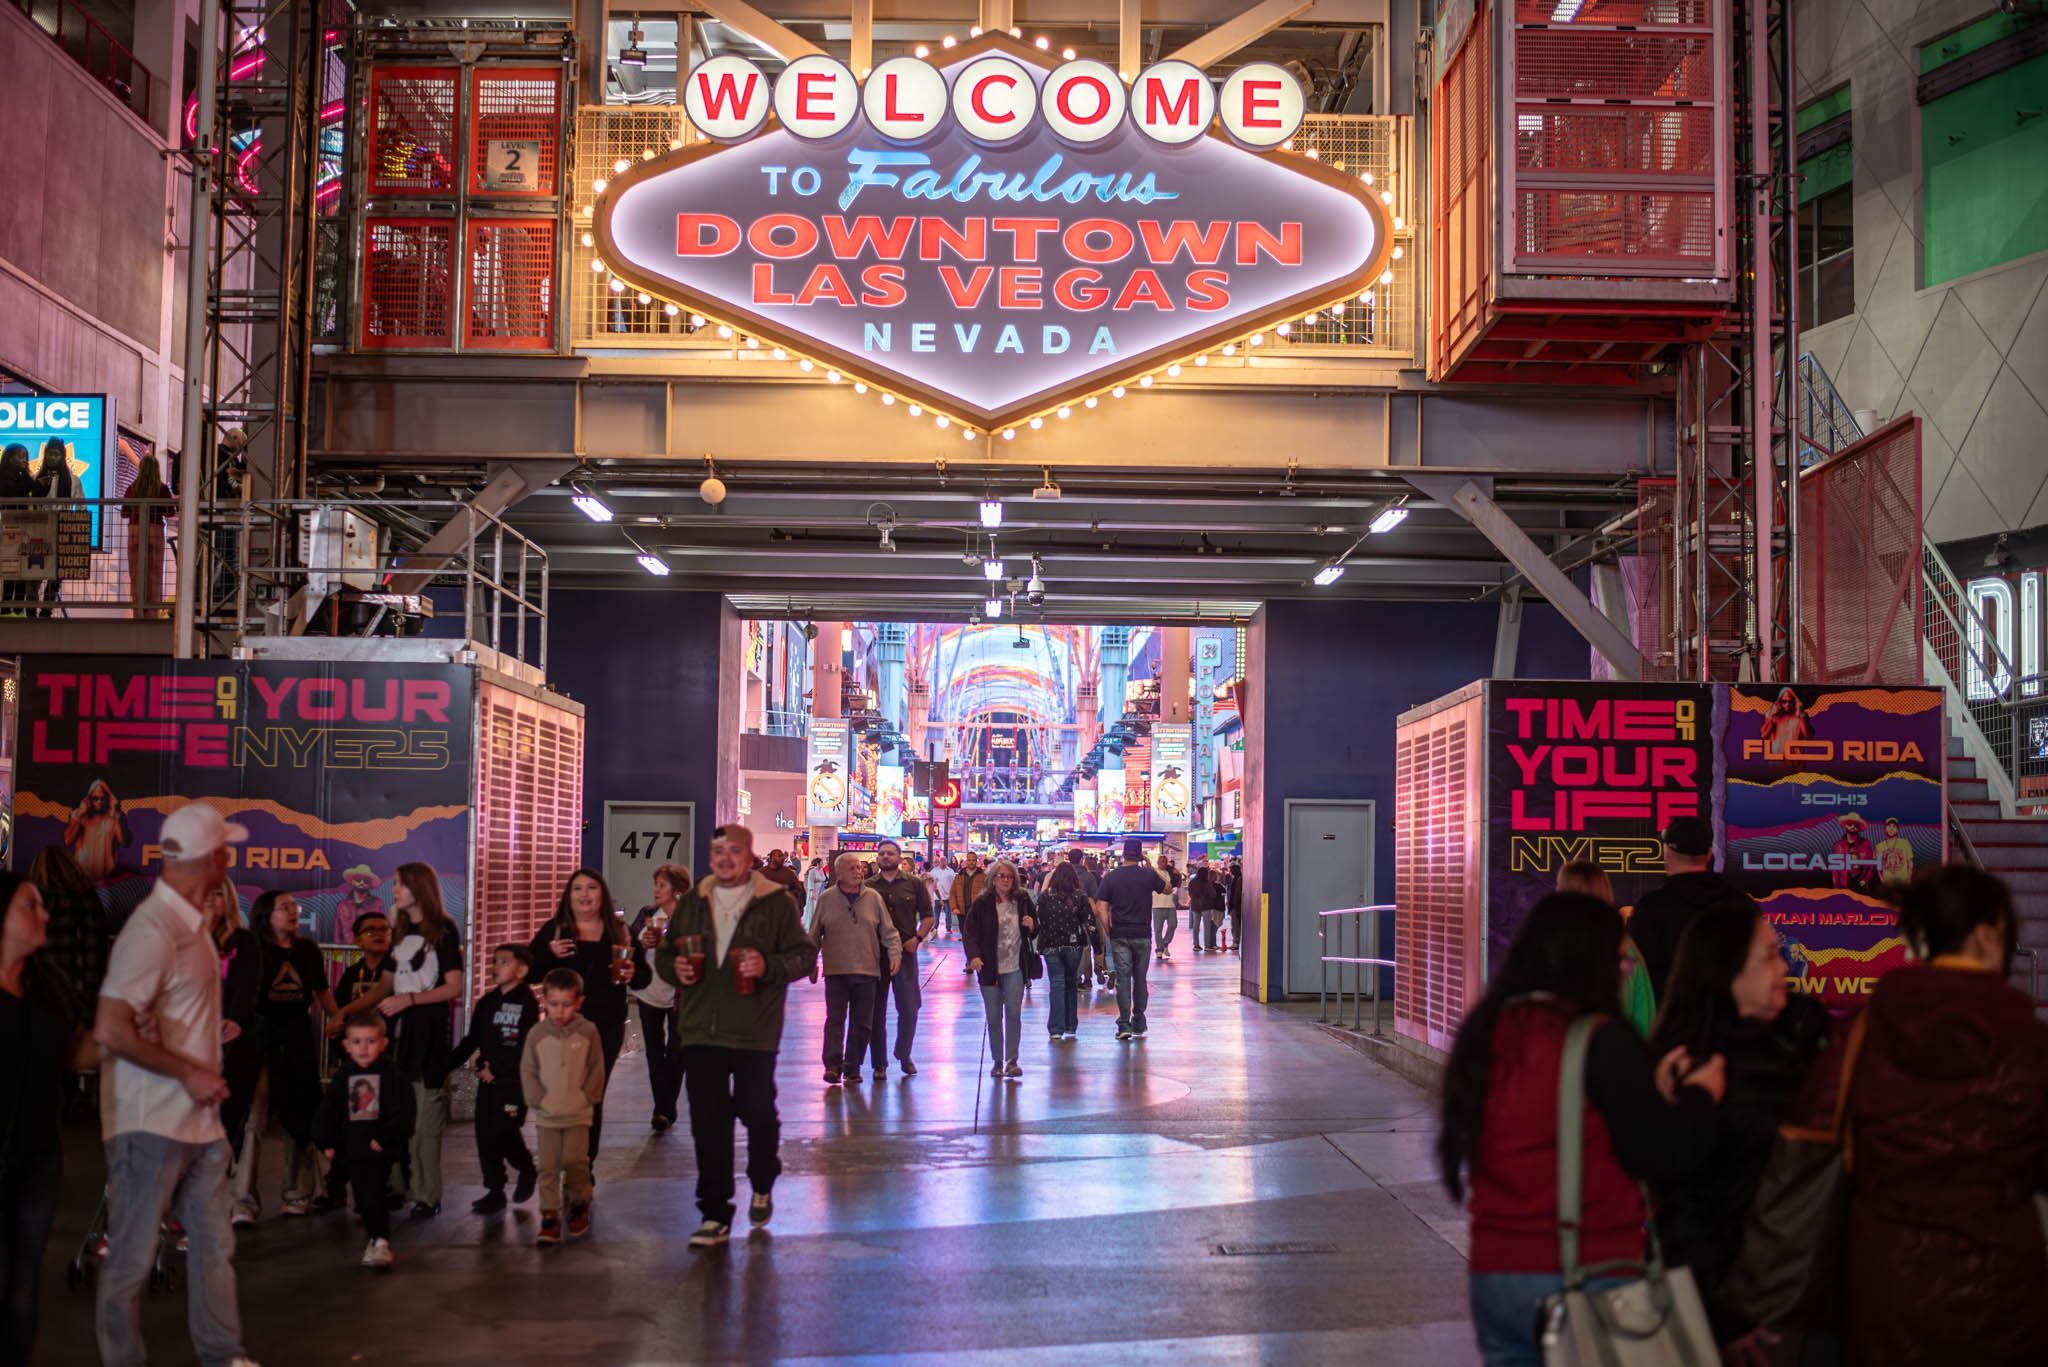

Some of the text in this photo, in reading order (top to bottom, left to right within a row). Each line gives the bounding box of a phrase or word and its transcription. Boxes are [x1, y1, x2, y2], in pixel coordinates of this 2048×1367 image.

[697, 73, 1284, 128] WELCOME
[501, 141, 527, 150] LEVEL
[505, 149, 521, 171] 2
[761, 147, 1180, 212] TO Fabulous
[675, 213, 1303, 266] DOWNTOWN
[752, 264, 1231, 312] LAS VEGAS
[864, 322, 1118, 355] NEVADA
[58, 567, 89, 579] OFFICE
[59, 556, 89, 567] TICKET
[37, 673, 451, 723] TIME OF YOUR
[1505, 698, 1696, 741] TIME OF
[32, 720, 450, 770] LIFE NYE25
[1743, 738, 1925, 763] FLO RIDA
[1505, 744, 1698, 788] YOUR
[1511, 789, 1699, 832] LIFE
[1801, 793, 1869, 806] 3OH!3
[775, 810, 795, 829] the
[246, 847, 332, 871] RIDA
[619, 831, 682, 860] 477
[1511, 836, 1668, 874] NYE2
[1742, 852, 1883, 871] LOCASH
[1783, 976, 1827, 994] OW
